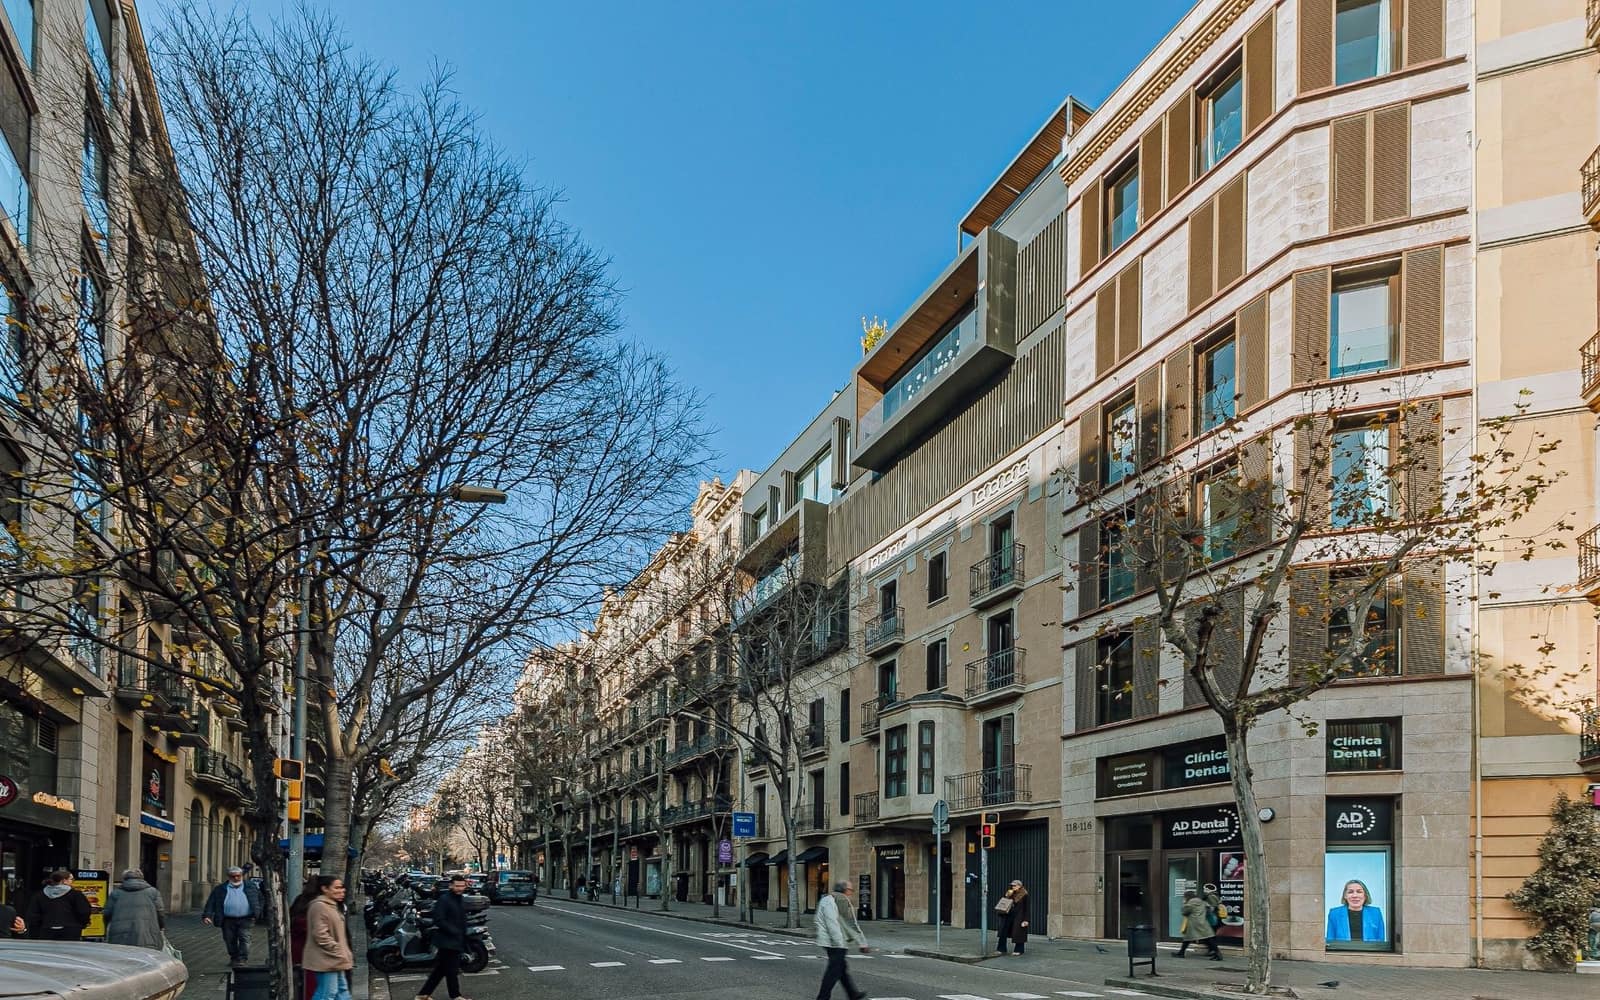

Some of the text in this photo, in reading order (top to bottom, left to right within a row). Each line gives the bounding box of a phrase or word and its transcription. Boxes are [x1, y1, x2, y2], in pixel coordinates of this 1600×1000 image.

[1333, 735, 1382, 746] Clínica
[1184, 750, 1230, 765] Clínica
[1333, 748, 1381, 758] Dental
[1184, 763, 1231, 778] Dental
[1336, 812, 1364, 823] AD
[1172, 817, 1229, 831] AD Dental
